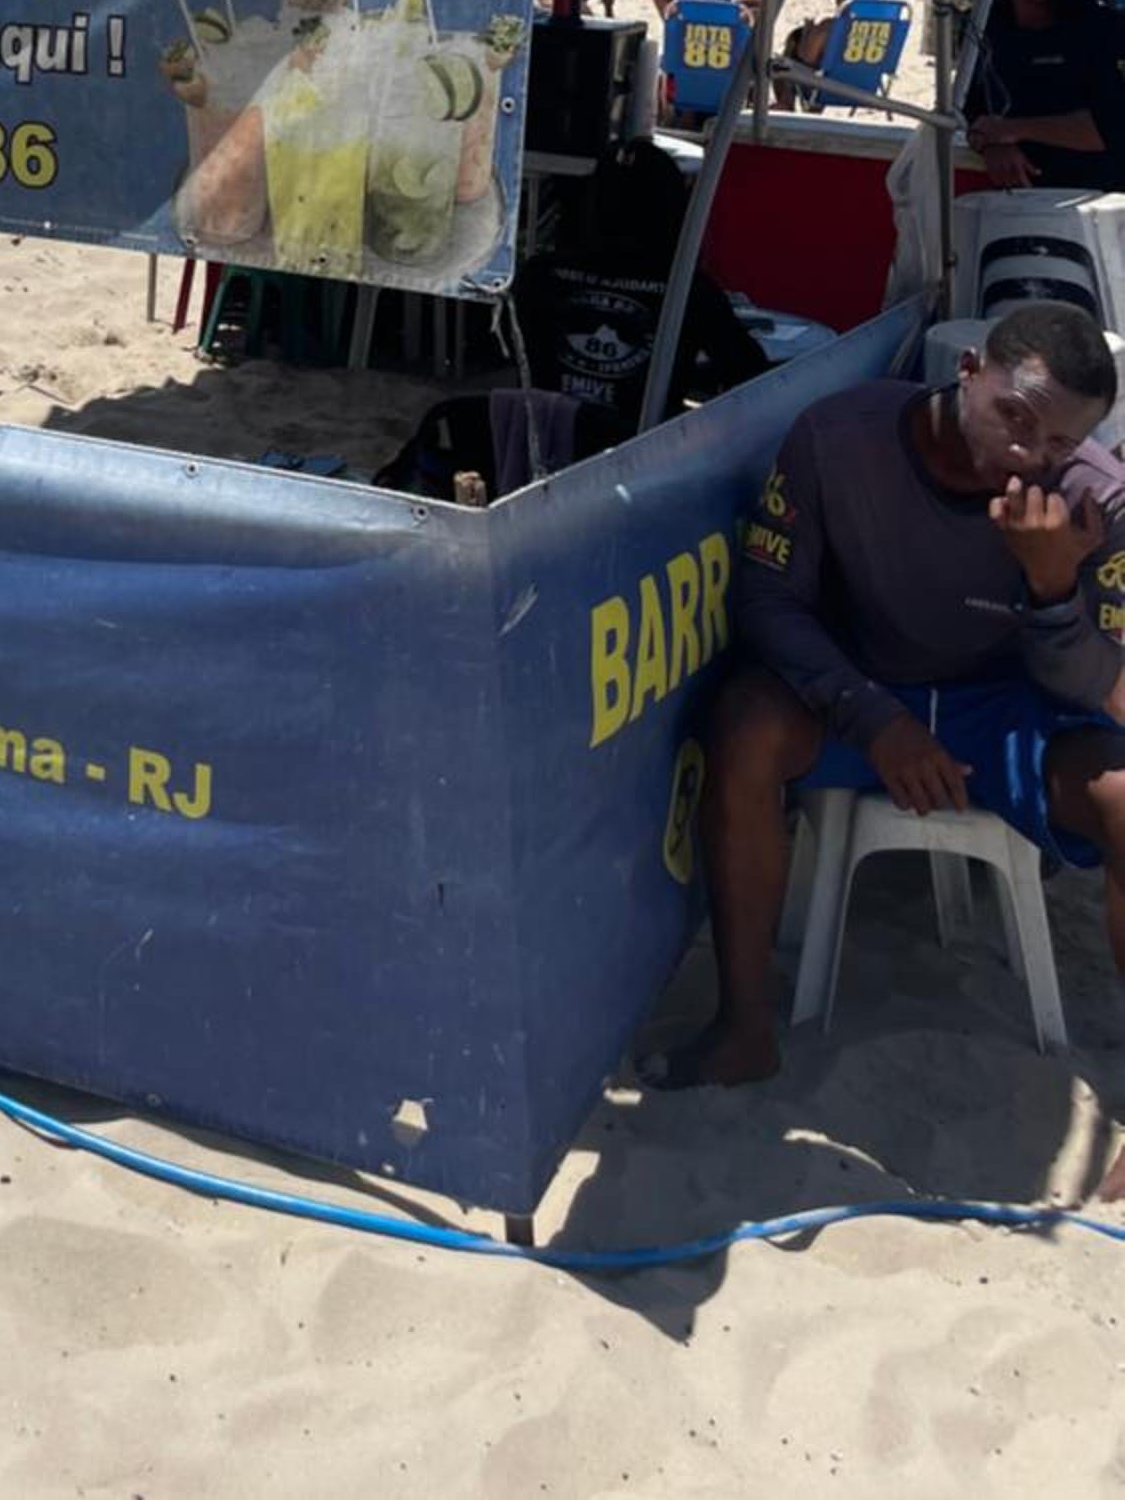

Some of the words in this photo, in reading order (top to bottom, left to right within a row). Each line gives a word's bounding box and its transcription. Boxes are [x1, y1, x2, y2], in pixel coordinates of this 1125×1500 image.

[684, 42, 731, 68] 86
[843, 39, 886, 64] 86
[585, 338, 617, 358] 86
[590, 533, 731, 748] BARR
[86, 763, 106, 781] -
[128, 746, 213, 820] RJ
